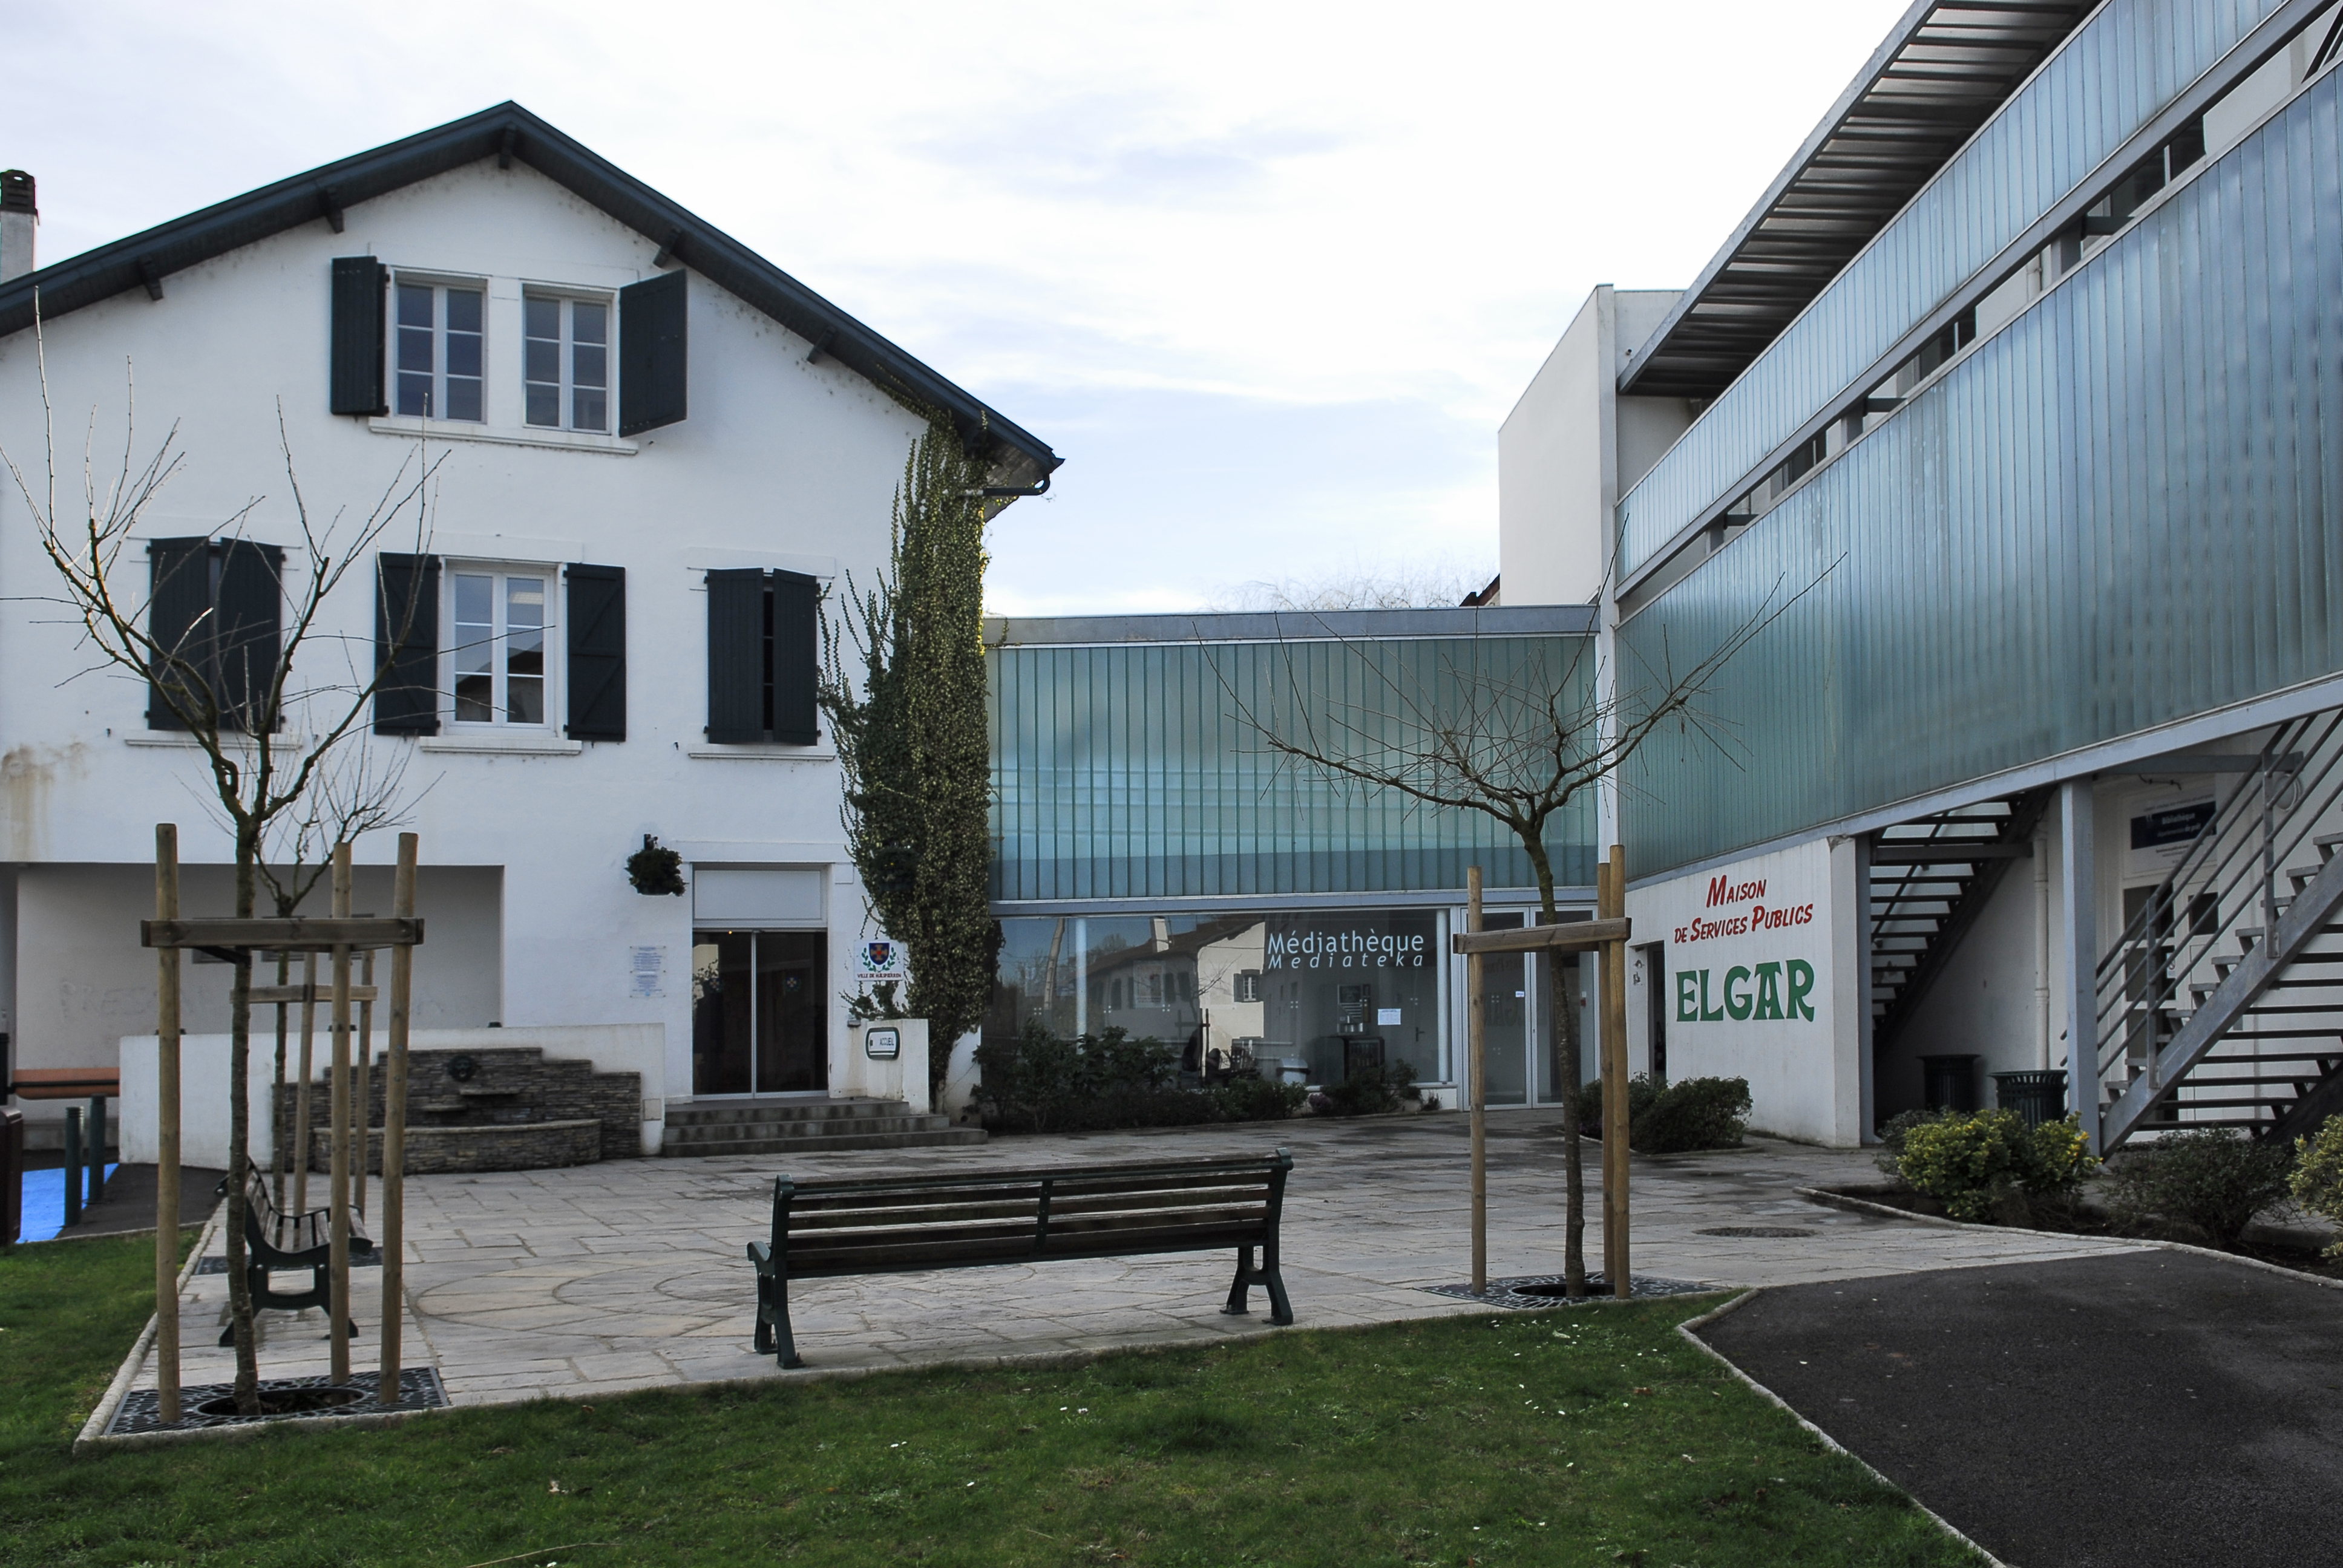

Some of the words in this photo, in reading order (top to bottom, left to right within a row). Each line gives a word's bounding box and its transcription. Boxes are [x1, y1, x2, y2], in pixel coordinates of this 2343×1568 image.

[1674, 927, 1687, 944] DE
[1690, 916, 1748, 941] SERVICES
[1752, 904, 1813, 932] PUBLICS
[1268, 929, 1424, 956] Médiathèque
[1268, 951, 1423, 969] Mediateka
[1676, 959, 1815, 1022] ELGAR
